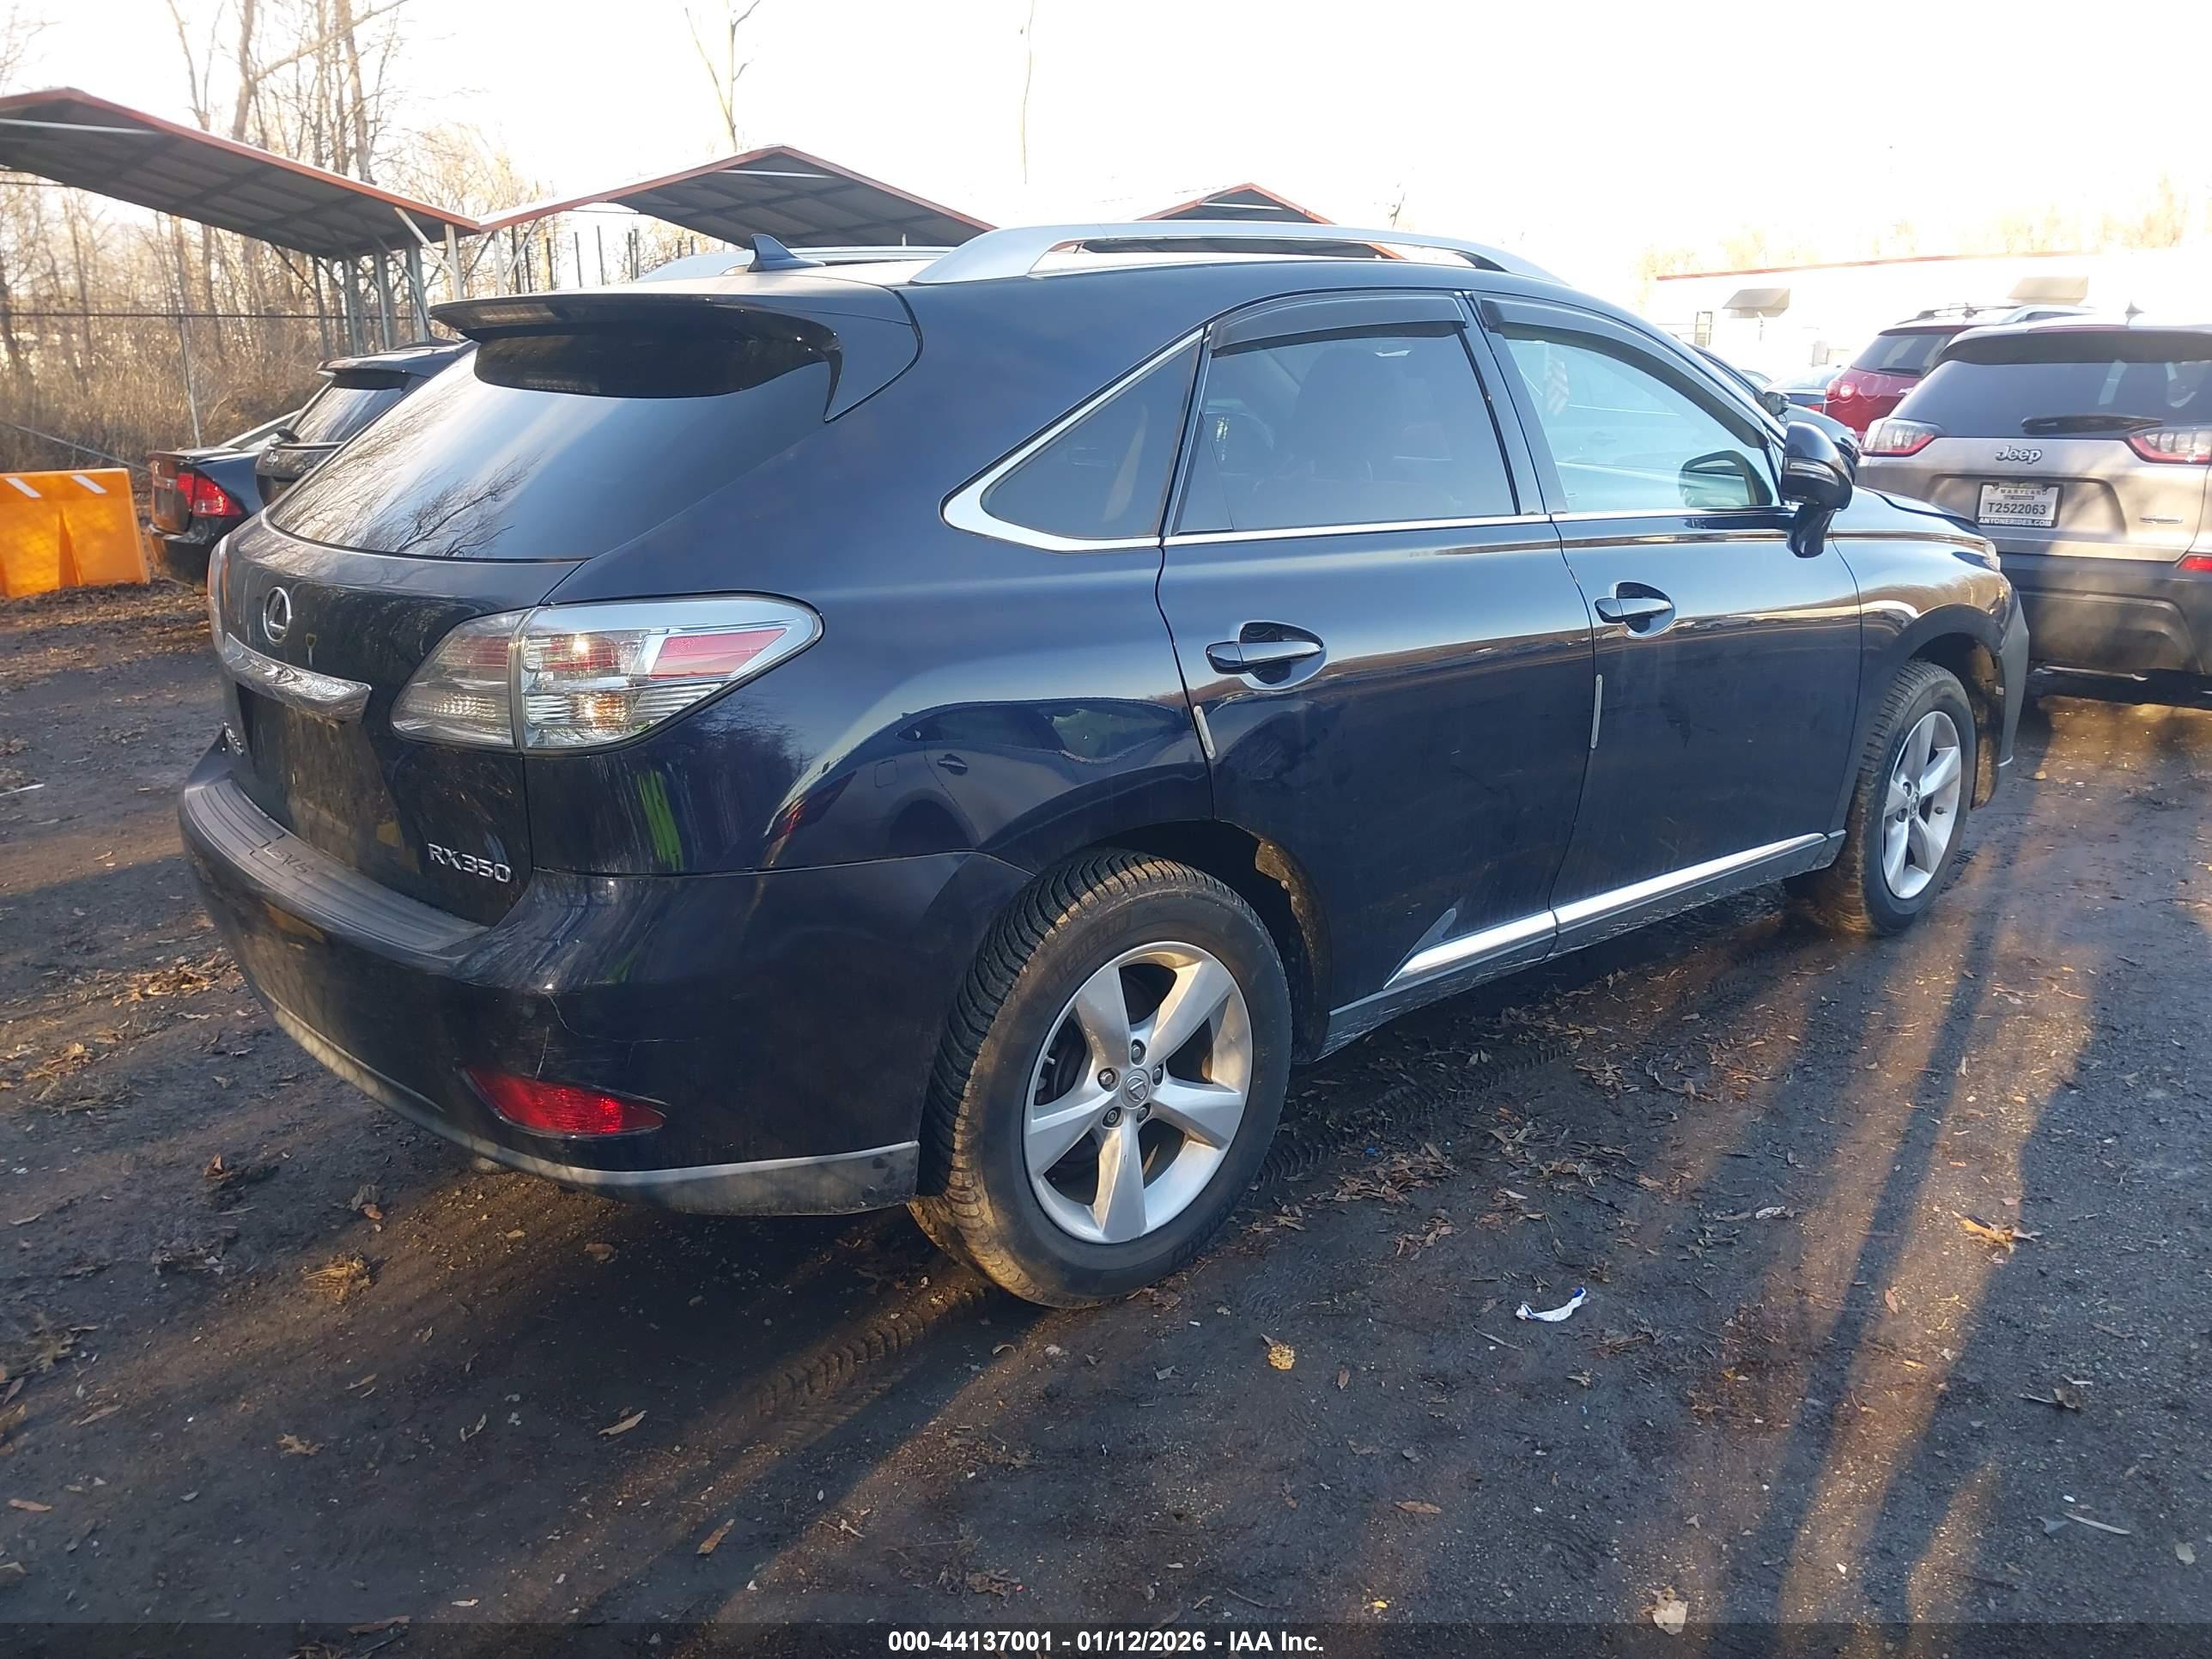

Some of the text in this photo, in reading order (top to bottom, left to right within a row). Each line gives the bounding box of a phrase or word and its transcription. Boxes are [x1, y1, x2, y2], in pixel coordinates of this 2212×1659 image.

[1995, 446, 2042, 464] Jeep
[1987, 502, 2046, 514] T2522063
[428, 842, 512, 883] RX350
